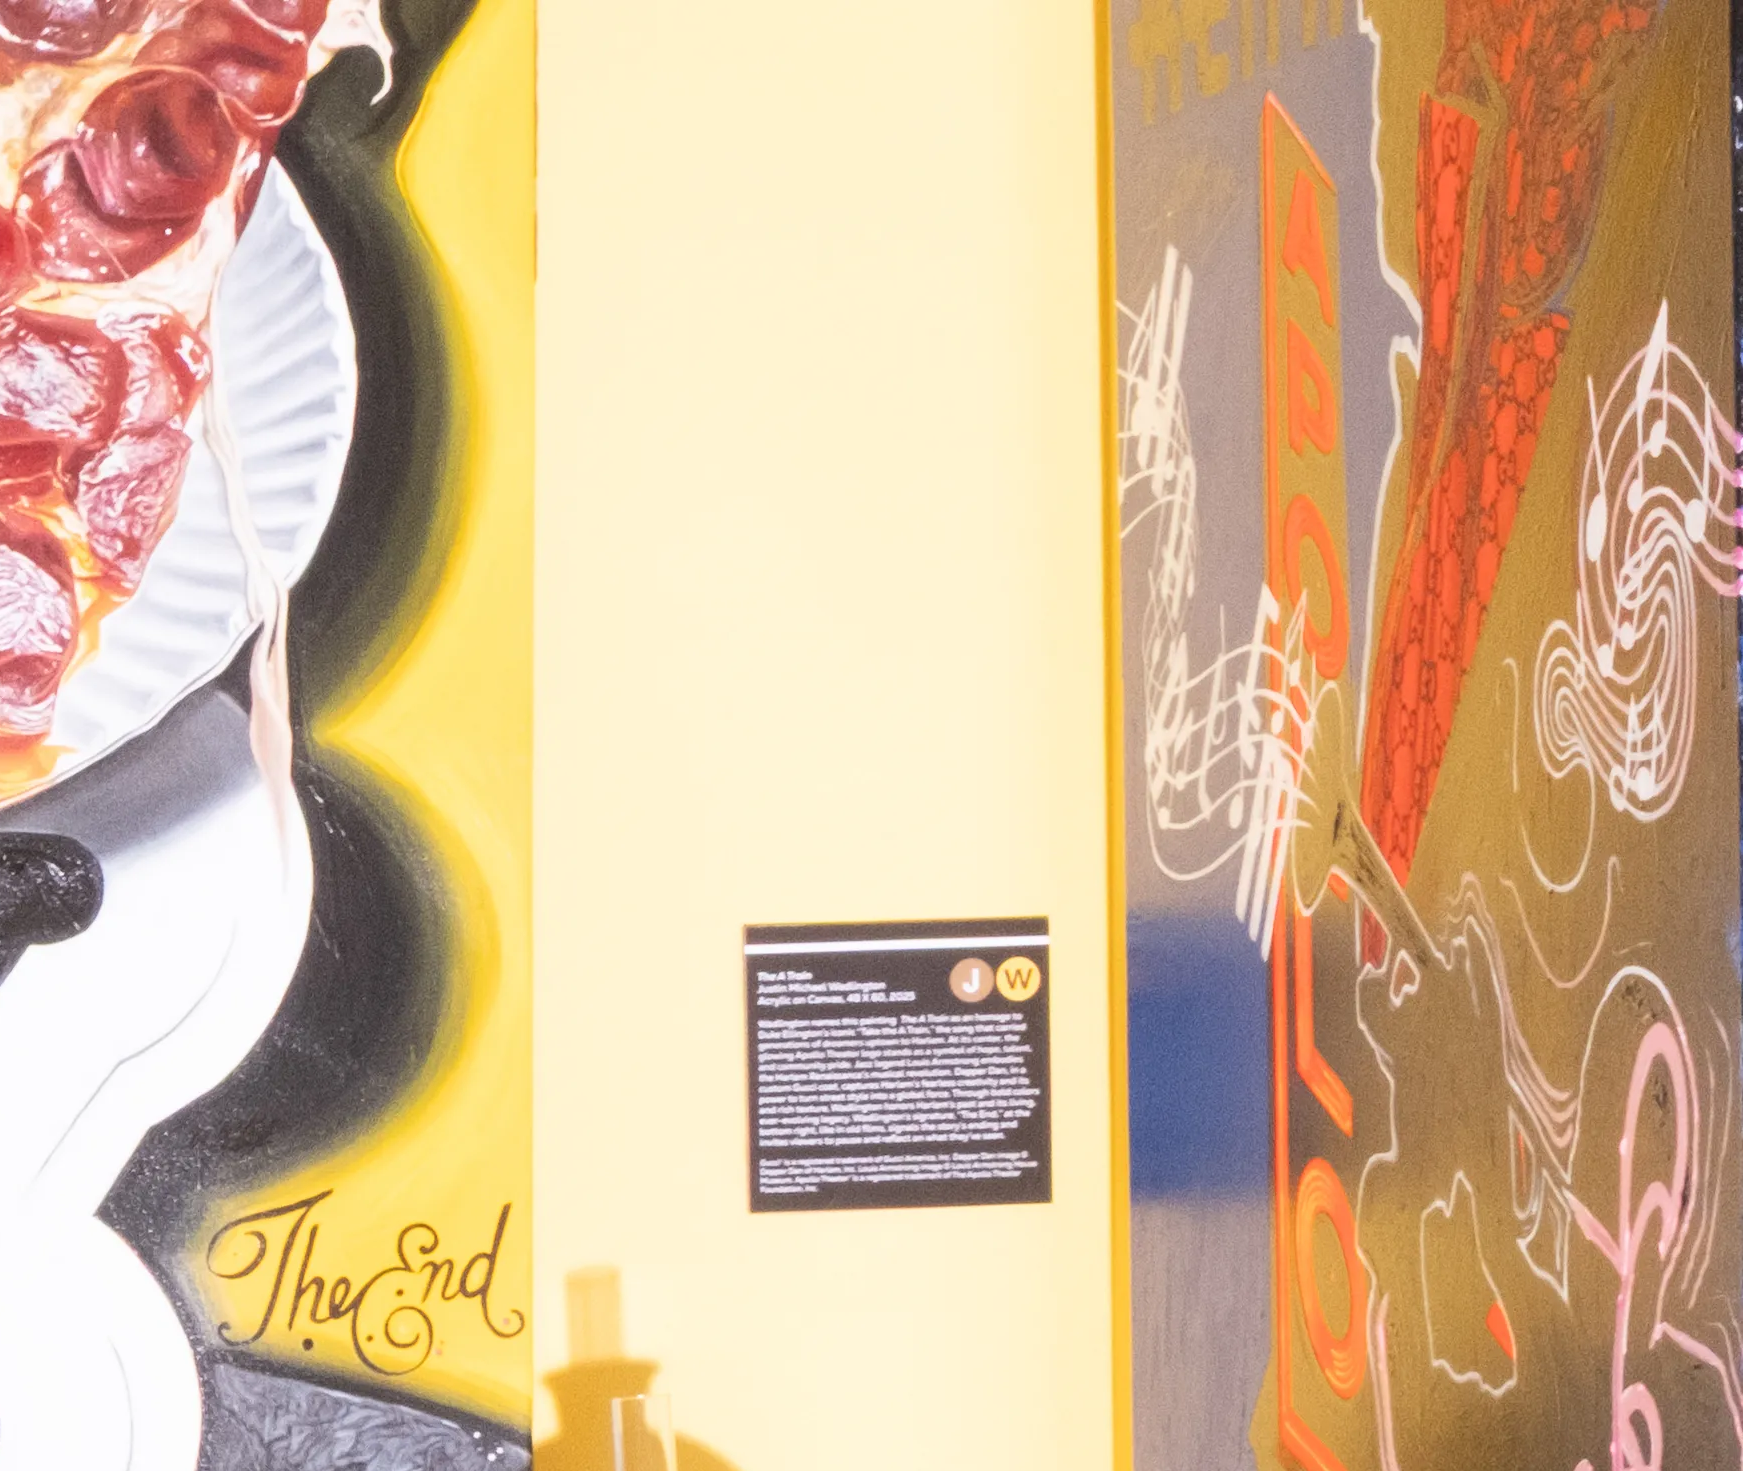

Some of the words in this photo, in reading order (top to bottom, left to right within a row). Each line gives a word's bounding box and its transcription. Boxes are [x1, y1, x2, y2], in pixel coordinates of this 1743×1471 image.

[962, 967, 980, 994] J
[1004, 968, 1034, 991] W
[206, 1188, 355, 1347] The
[351, 1202, 525, 1375] End
